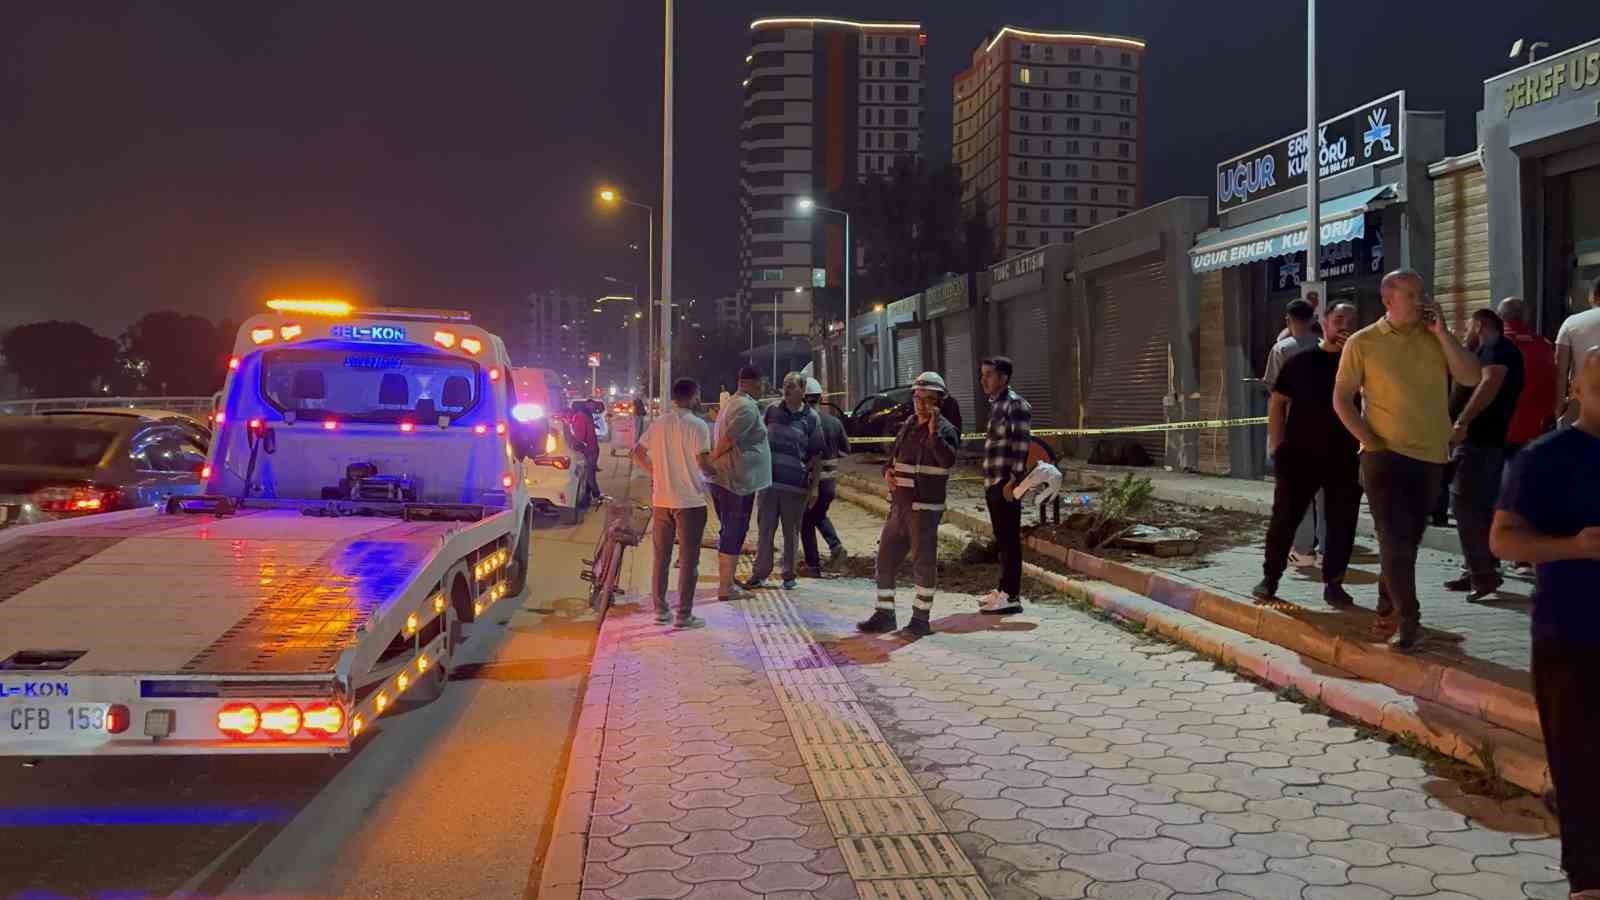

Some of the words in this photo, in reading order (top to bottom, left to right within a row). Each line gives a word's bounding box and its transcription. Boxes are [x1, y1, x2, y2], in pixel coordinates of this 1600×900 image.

[1504, 63, 1566, 119] ŞEREF
[1288, 127, 1328, 158] ERKK
[1231, 239, 1273, 261] ERKEK
[10, 707, 51, 731] CFB
[67, 706, 104, 731] 153
